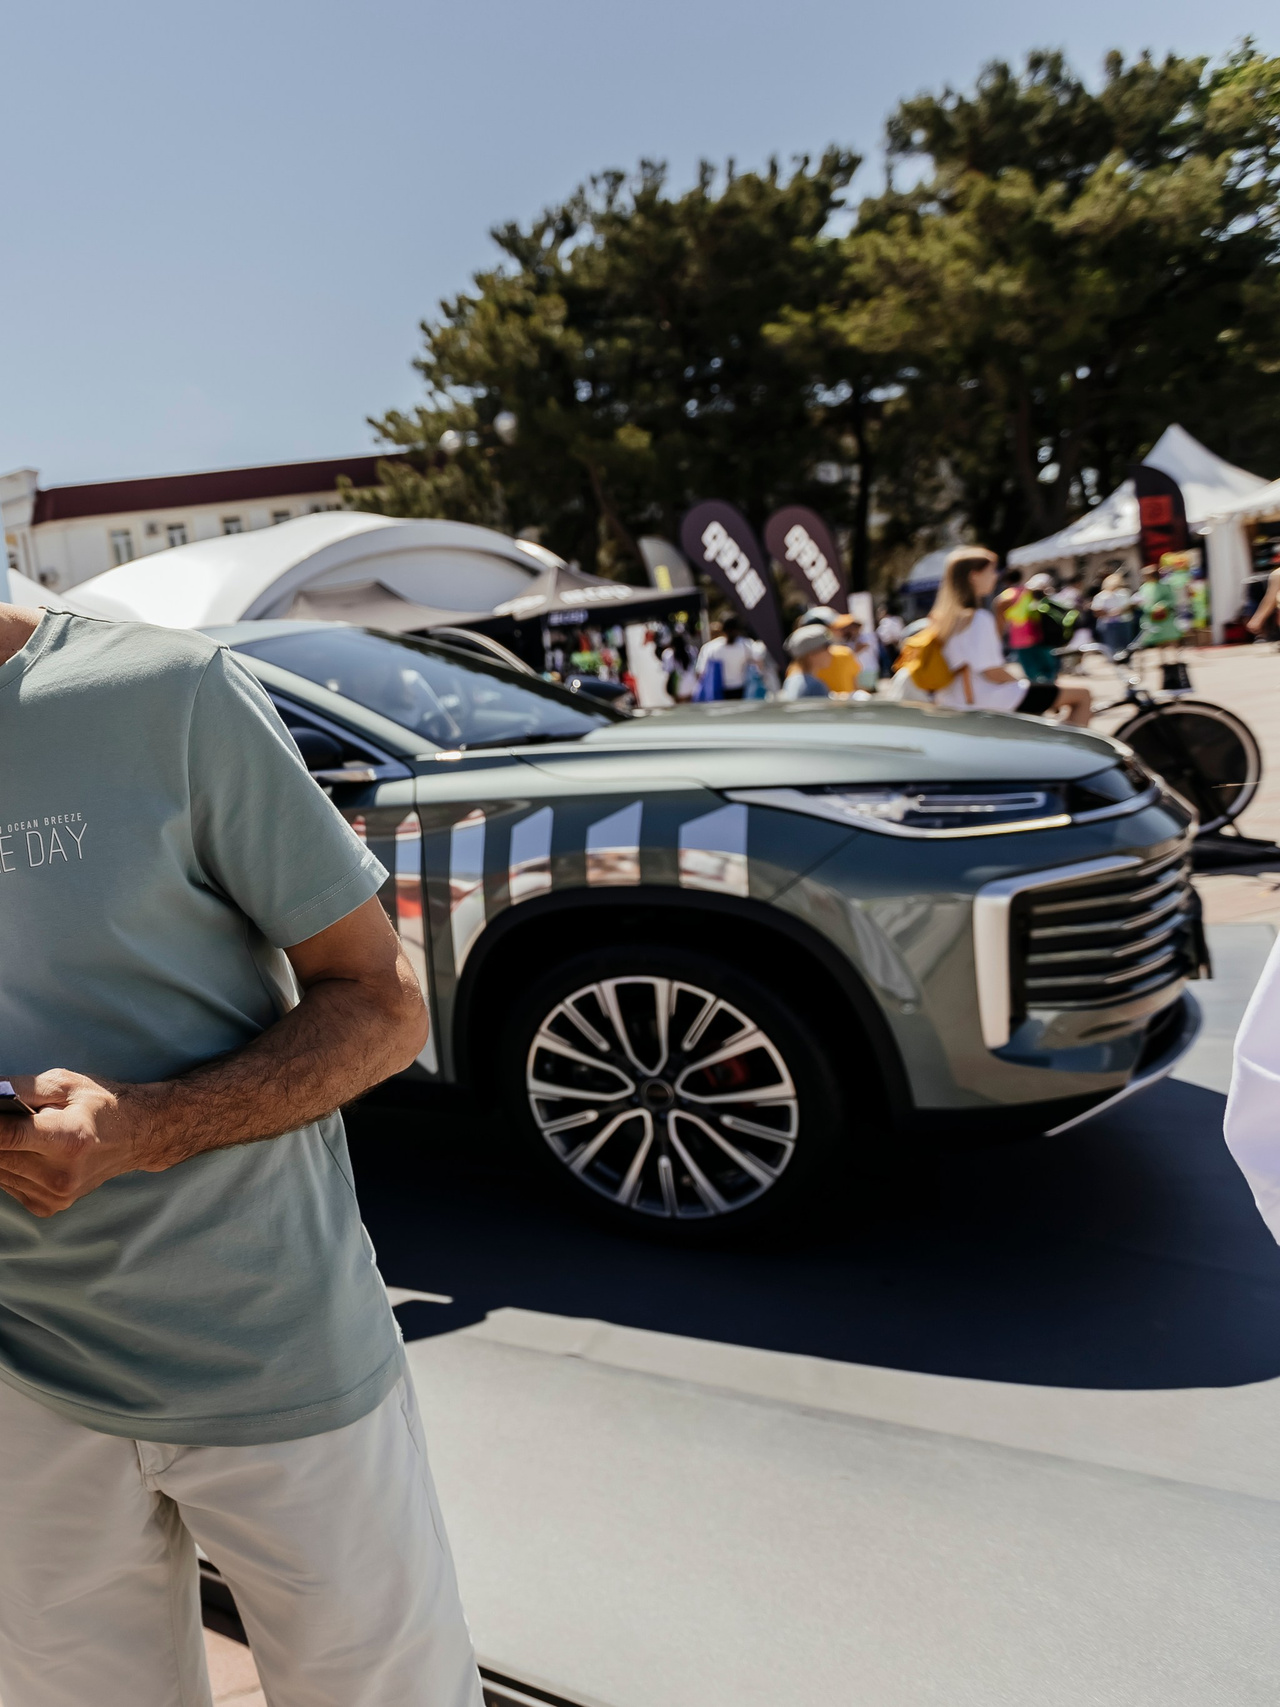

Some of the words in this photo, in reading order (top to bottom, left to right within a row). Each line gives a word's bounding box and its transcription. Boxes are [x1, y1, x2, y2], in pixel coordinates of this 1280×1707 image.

[7, 819, 39, 833] OCEAN
[44, 812, 83, 826] BREEZE
[25, 822, 88, 868] DAY
